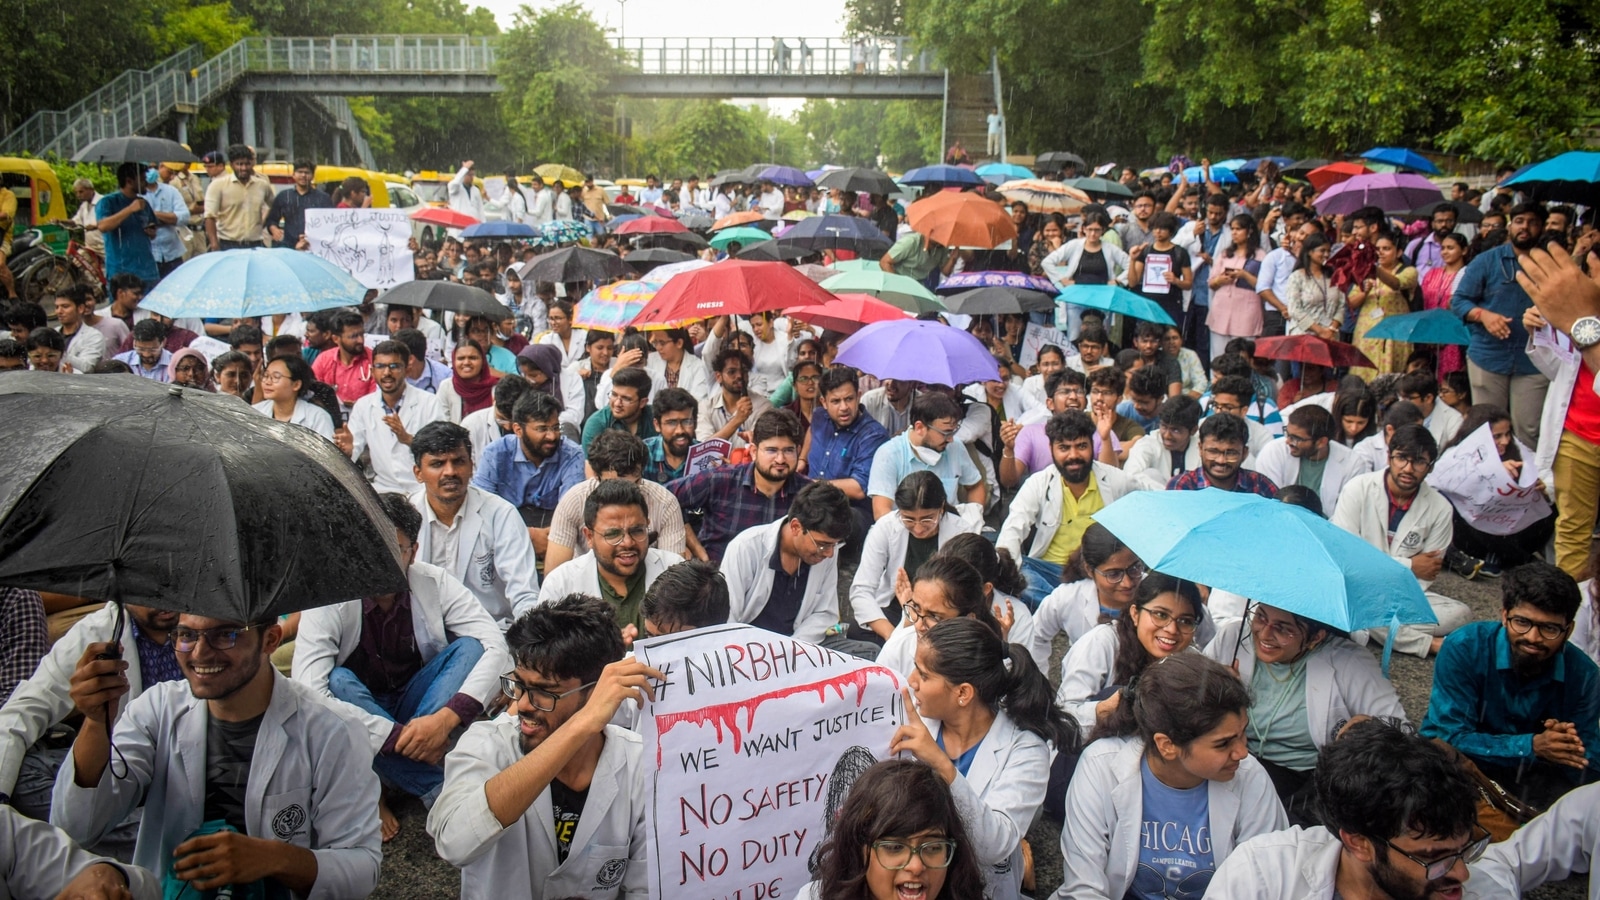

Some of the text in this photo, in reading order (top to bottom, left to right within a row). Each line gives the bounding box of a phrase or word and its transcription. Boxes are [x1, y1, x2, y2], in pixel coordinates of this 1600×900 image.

[696, 301, 724, 309] INESIS
[680, 747, 720, 774] WE
[743, 727, 802, 758] WANT
[680, 773, 828, 836] NO SAFETY
[679, 843, 729, 886] NO
[741, 828, 807, 871] DUTY
[1175, 858, 1197, 868] LEADER
